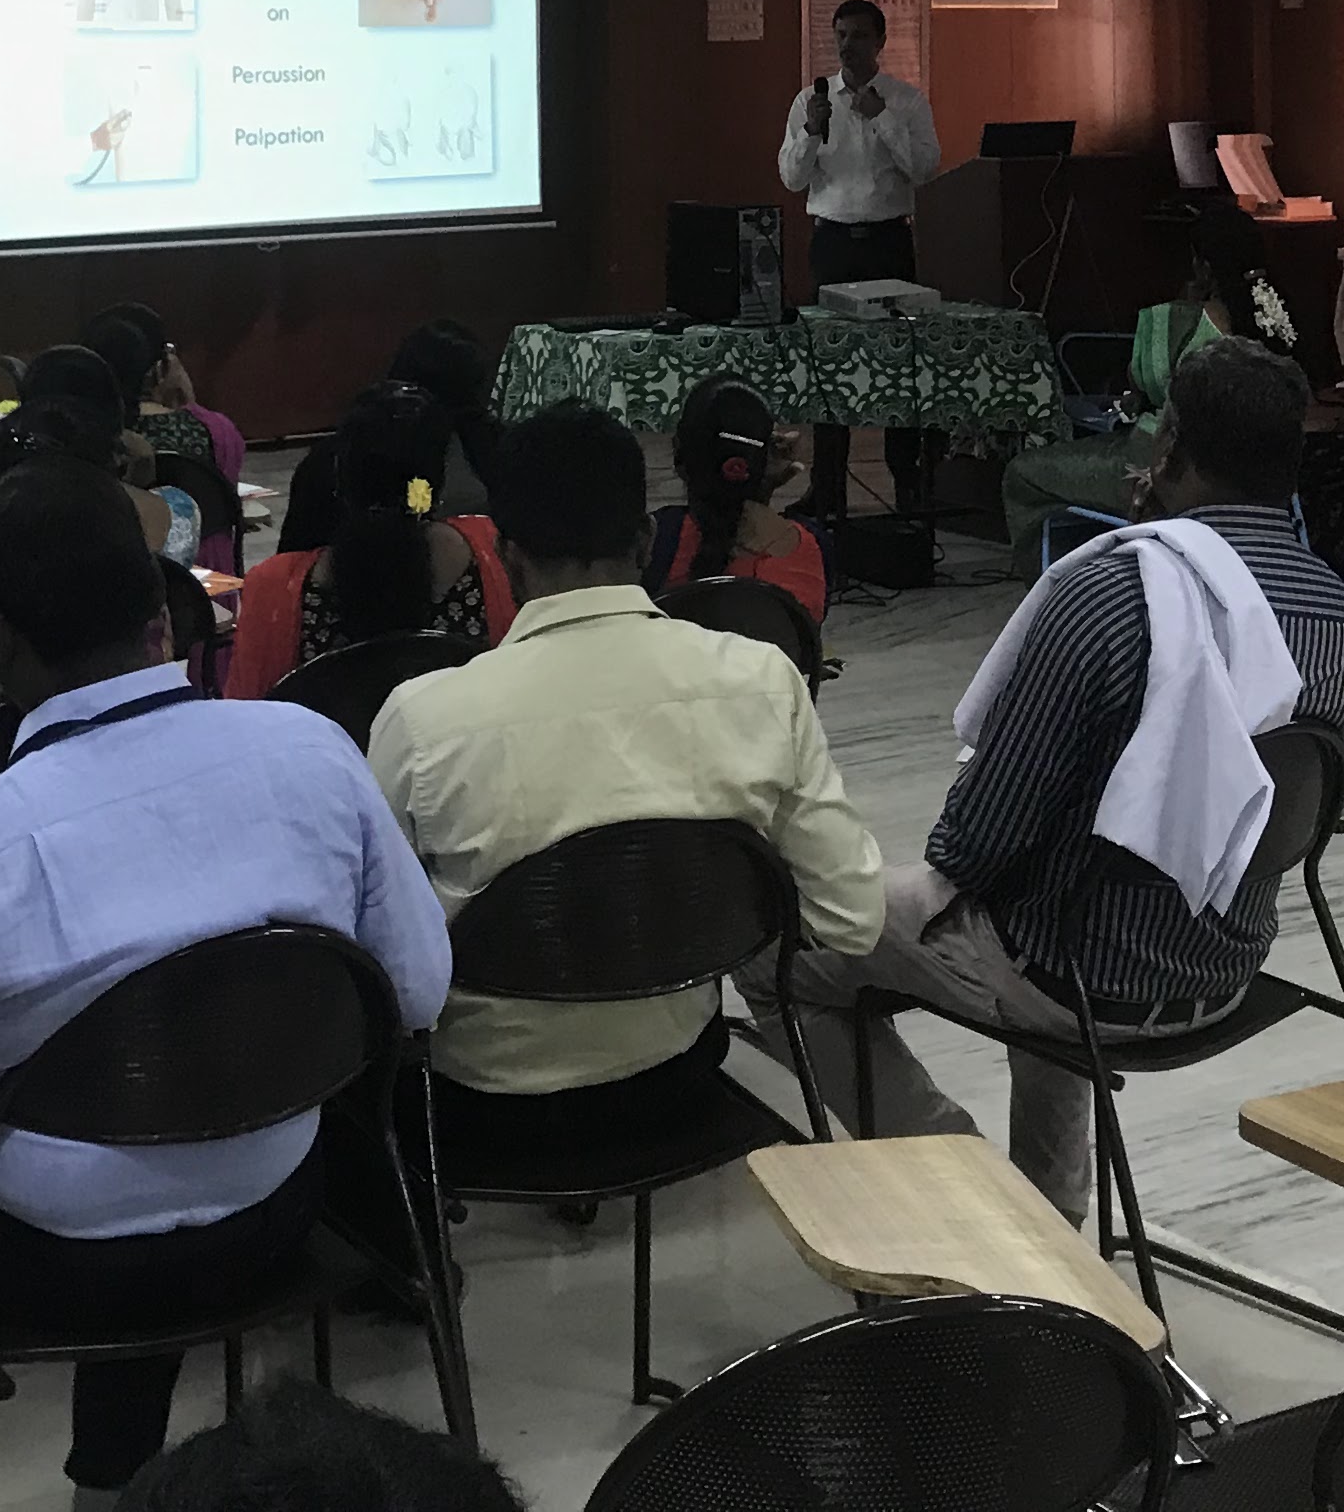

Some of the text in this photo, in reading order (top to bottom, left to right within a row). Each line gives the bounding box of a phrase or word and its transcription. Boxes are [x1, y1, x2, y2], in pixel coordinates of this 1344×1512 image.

[267, 7, 290, 22] on
[232, 65, 326, 84] Percussion
[235, 125, 325, 150] Palpation
